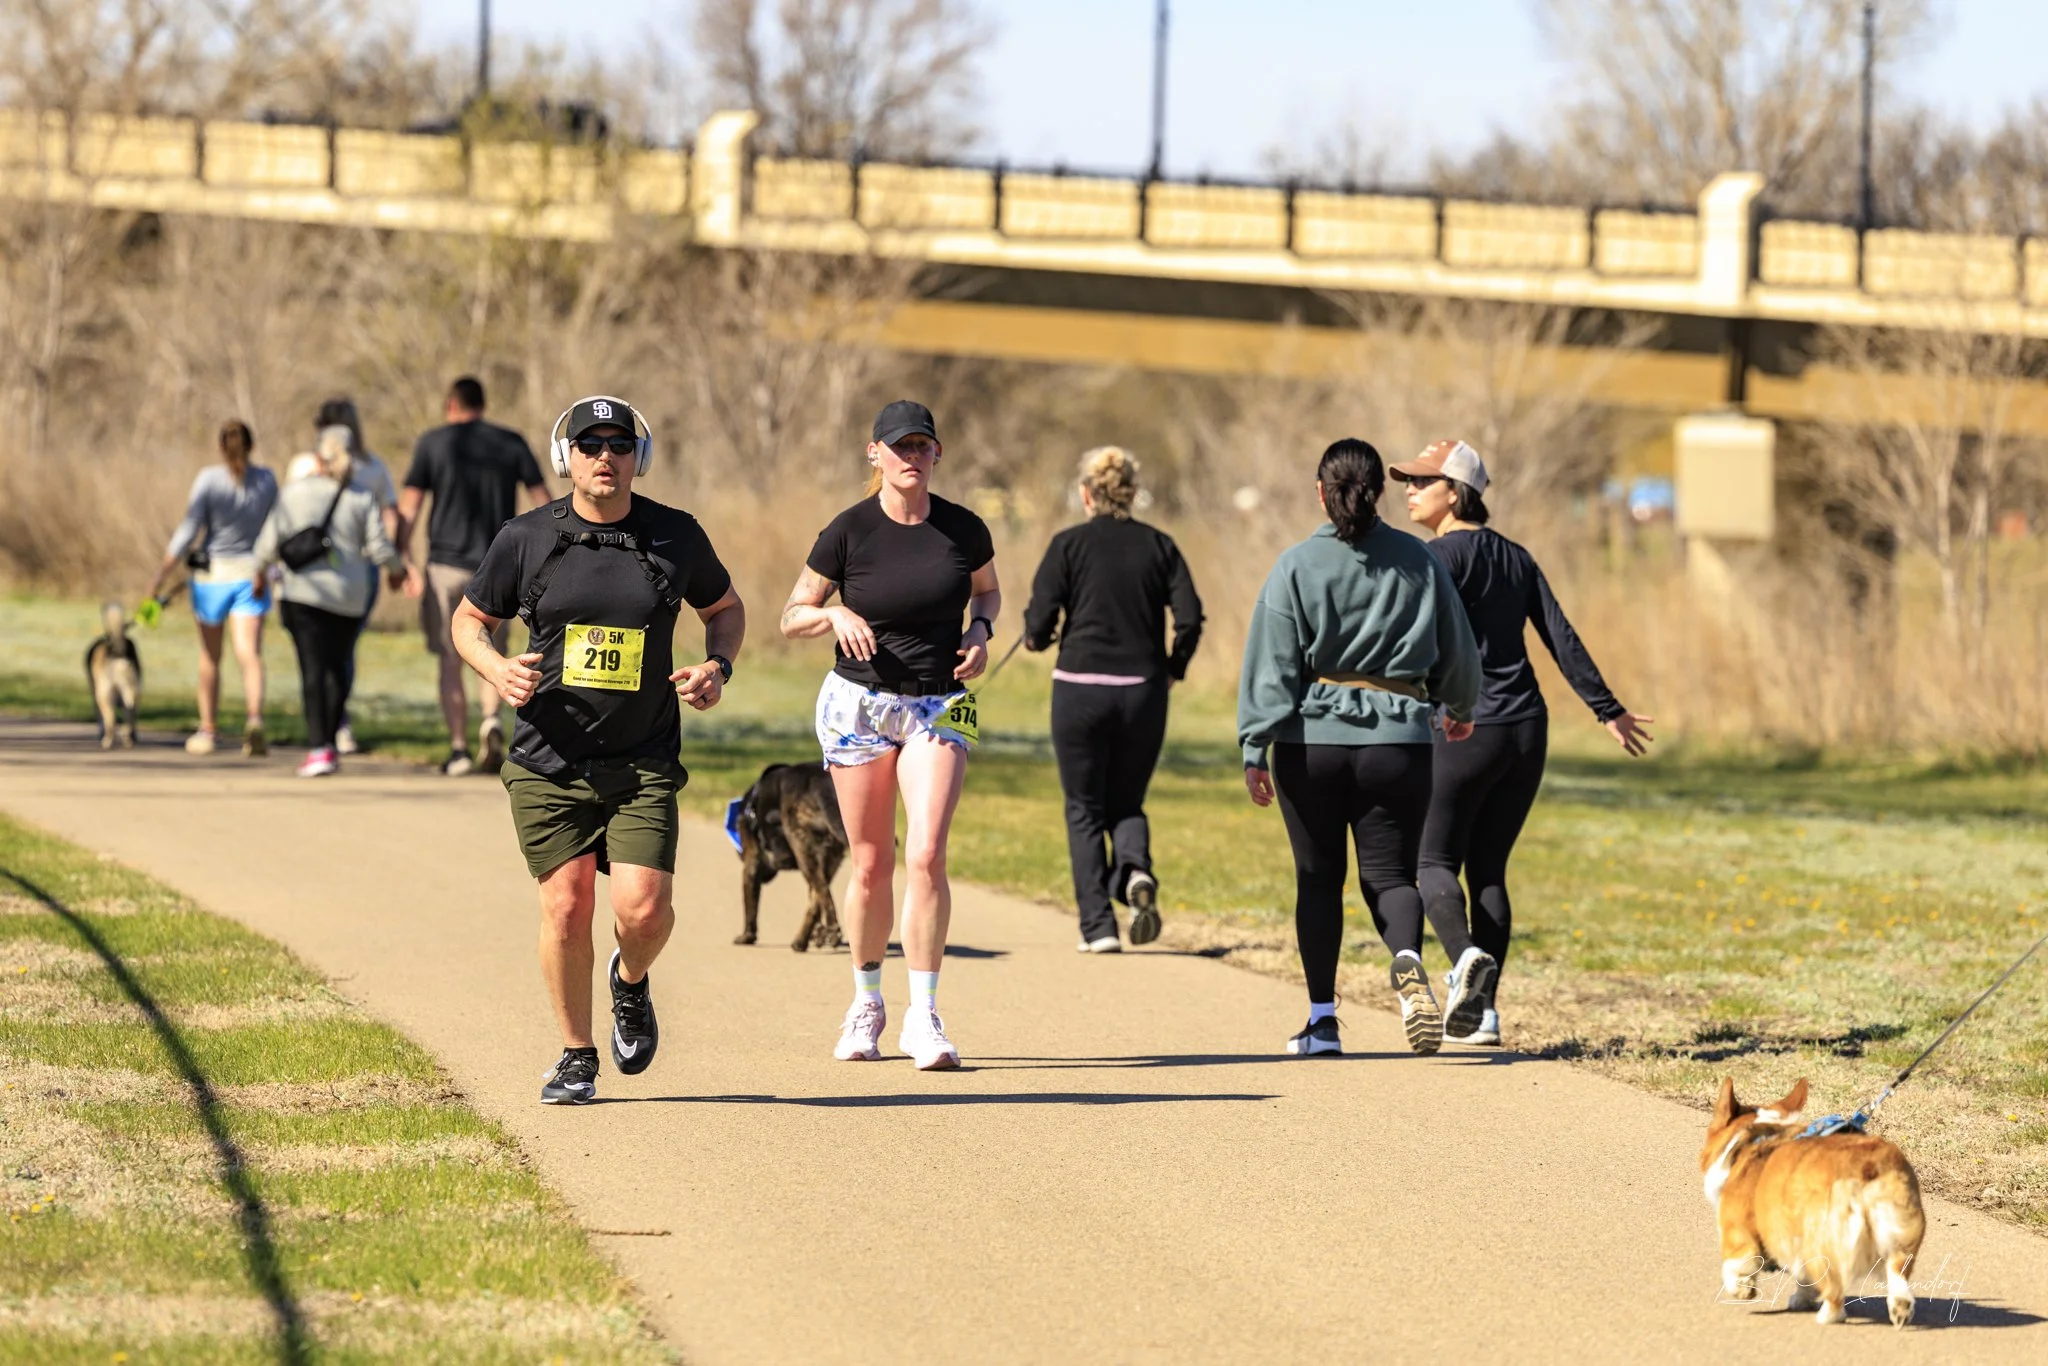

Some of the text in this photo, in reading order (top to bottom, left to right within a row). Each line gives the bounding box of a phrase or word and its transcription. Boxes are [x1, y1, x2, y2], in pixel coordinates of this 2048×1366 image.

[608, 631, 625, 645] 5K
[584, 647, 621, 672] 219
[968, 693, 977, 704] 5
[951, 706, 977, 728] 374
